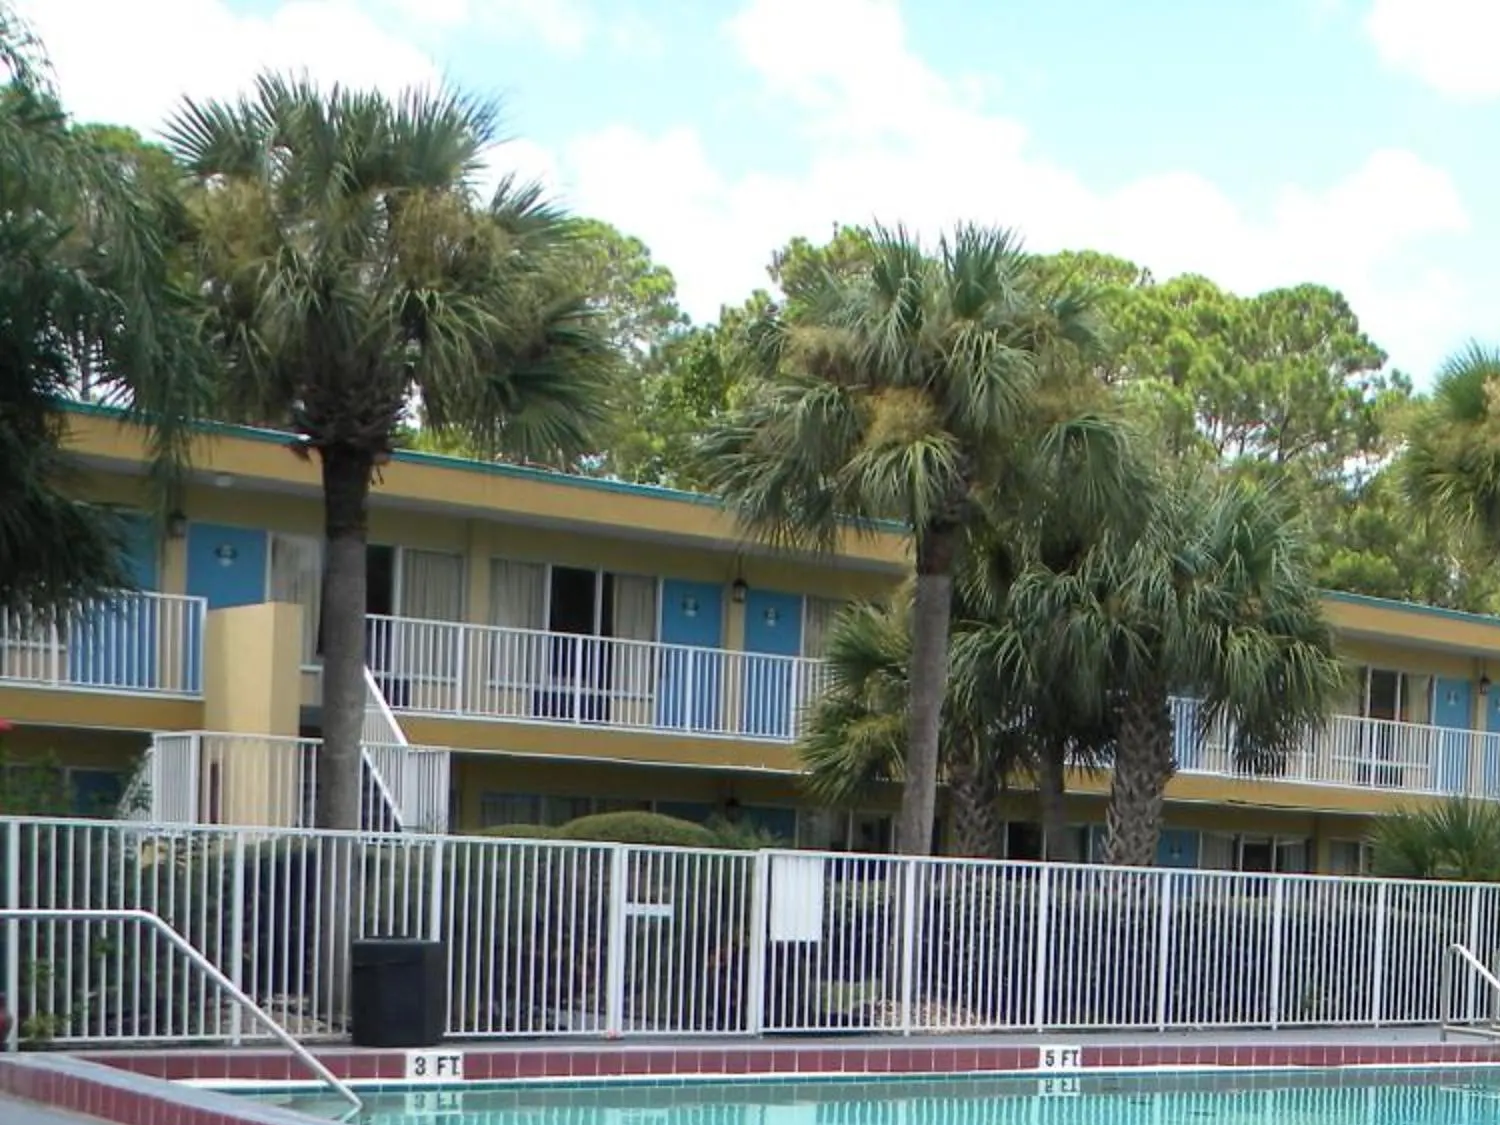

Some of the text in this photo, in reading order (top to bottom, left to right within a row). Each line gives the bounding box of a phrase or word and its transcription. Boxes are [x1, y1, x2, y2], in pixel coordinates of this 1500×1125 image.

[415, 1056, 426, 1076] 3
[1045, 1049, 1079, 1067] 5 FT
